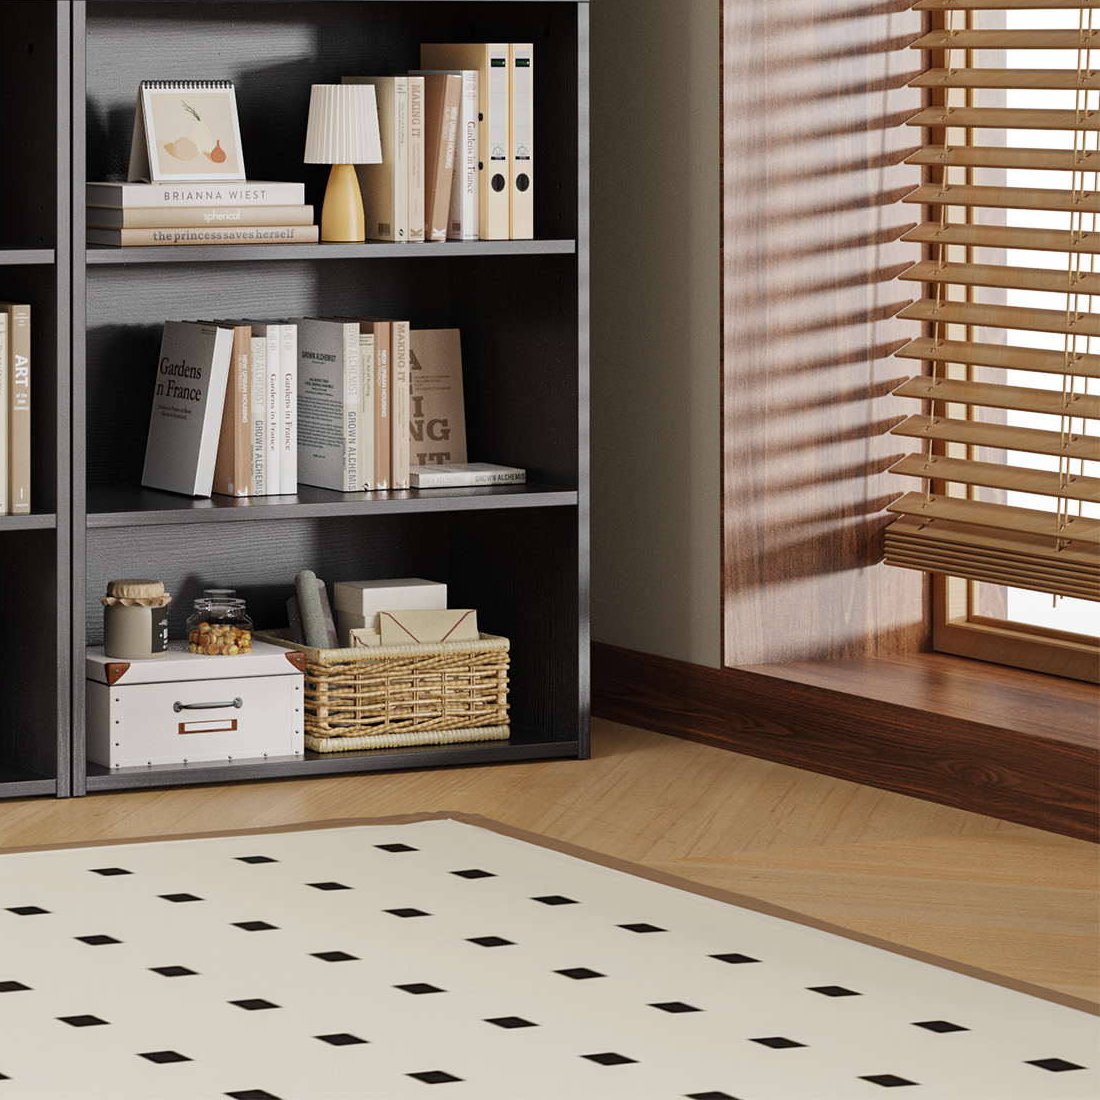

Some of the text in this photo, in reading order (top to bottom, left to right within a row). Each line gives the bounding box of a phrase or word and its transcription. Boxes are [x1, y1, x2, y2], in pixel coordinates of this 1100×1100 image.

[412, 84, 420, 125] MAKING
[412, 126, 420, 138] IT
[467, 121, 475, 194] Gardens in France
[164, 190, 266, 200] BRIANNA WIEST
[203, 209, 241, 223] spherical
[153, 229, 295, 243] the princess saves herself
[397, 325, 405, 383] MAKING IT
[15, 354, 28, 387] ART
[160, 357, 202, 379] Gardens
[156, 379, 202, 401] n France
[270, 411, 276, 421] in
[285, 411, 292, 420] in
[255, 420, 263, 495] GROWN ALCHEMIS
[348, 412, 356, 491] GROWN ALCHEMIS
[497, 473, 526, 481] ALCHEMIS
